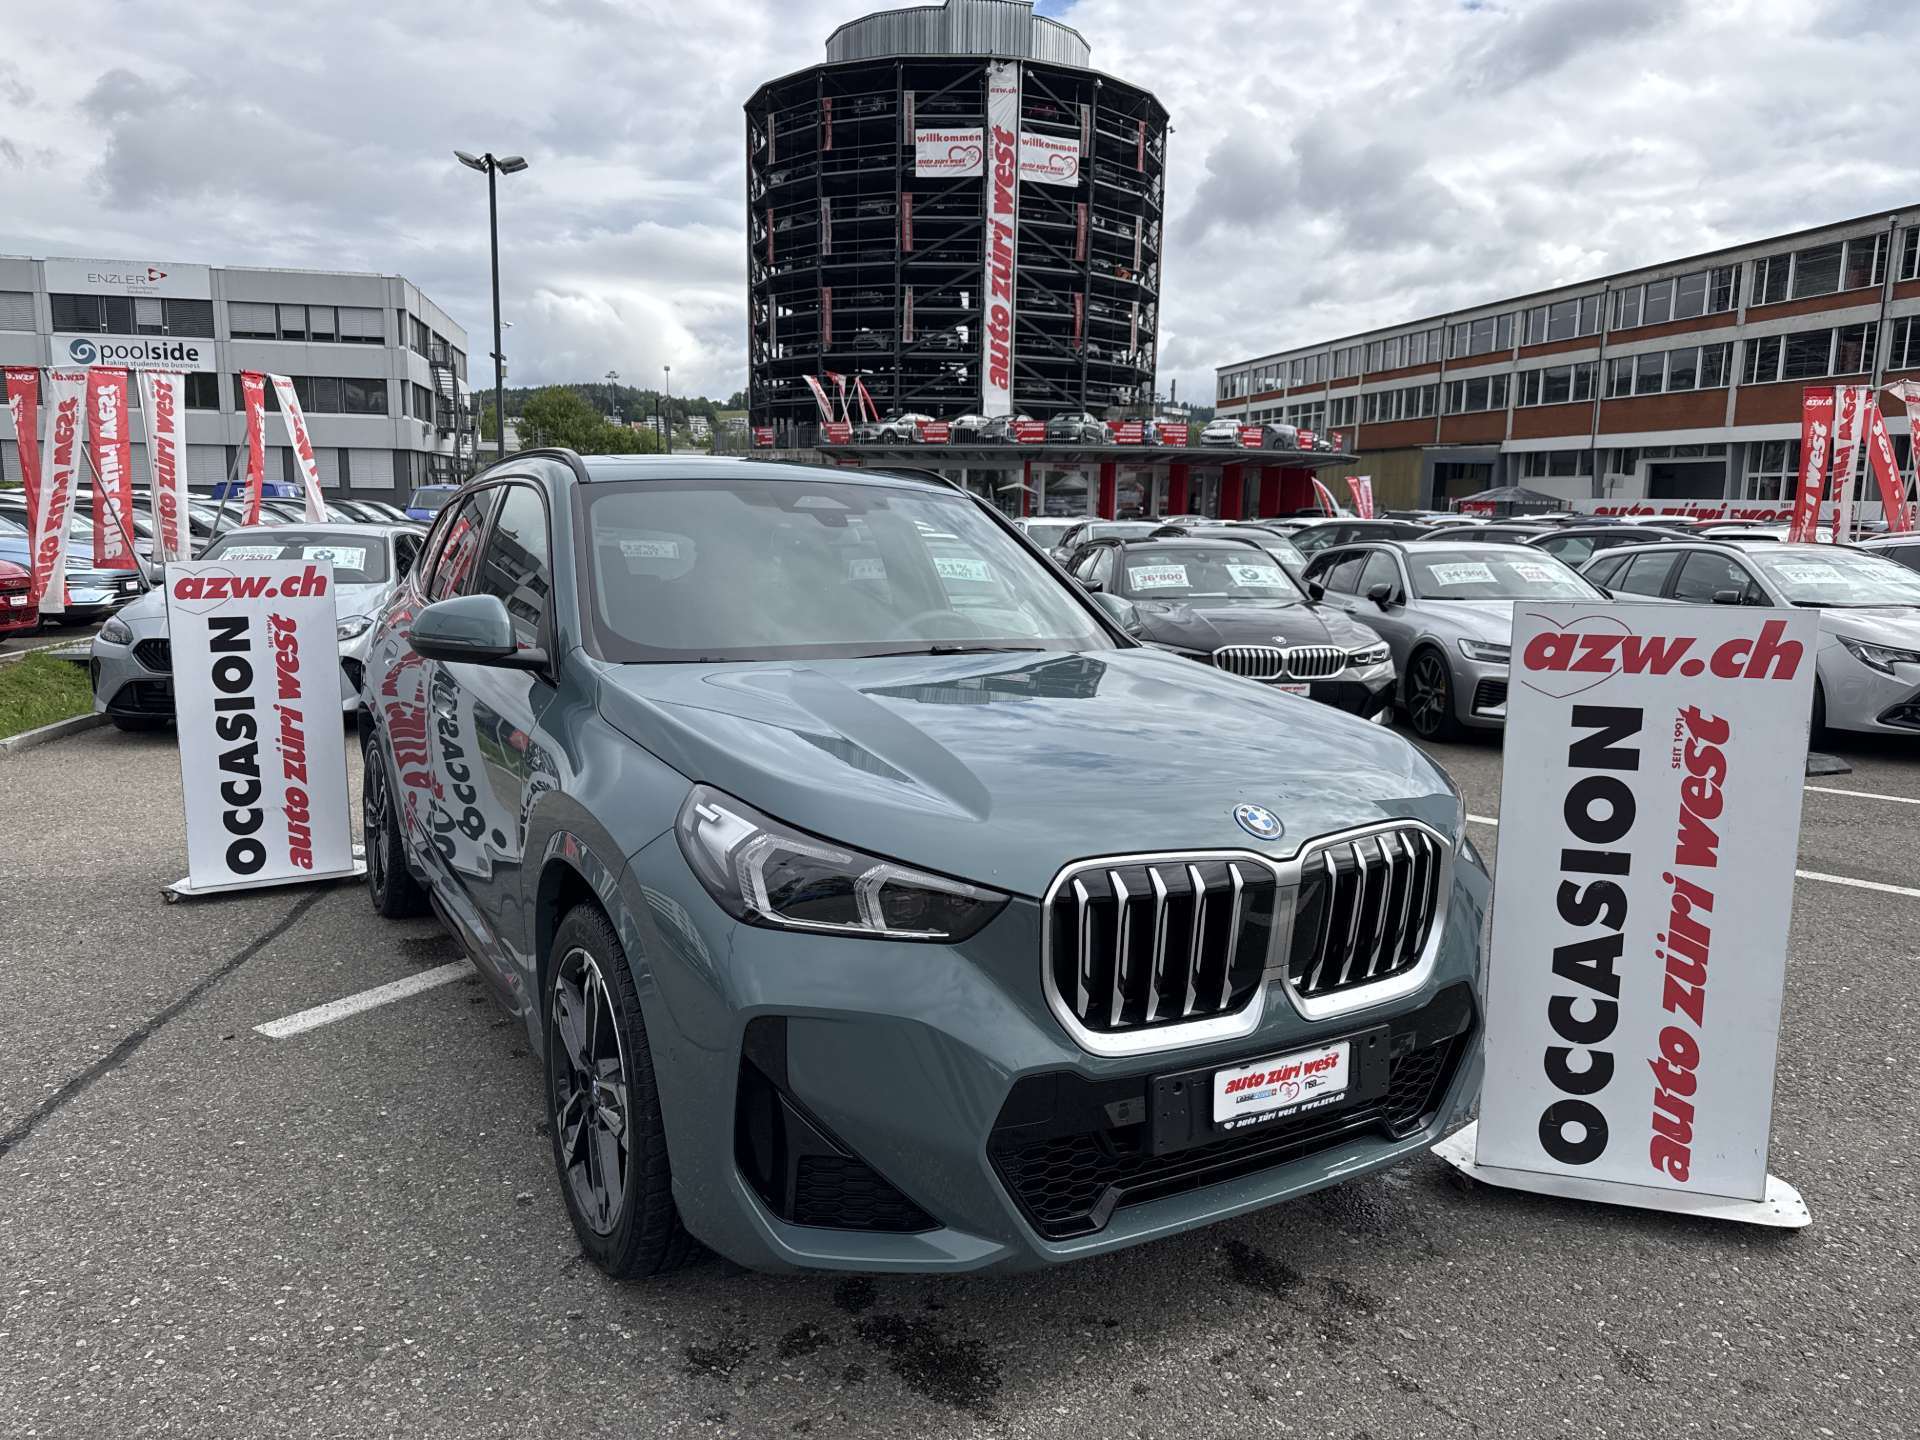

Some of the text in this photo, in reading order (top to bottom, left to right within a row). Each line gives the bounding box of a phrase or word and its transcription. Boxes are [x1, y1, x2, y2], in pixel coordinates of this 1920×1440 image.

[917, 133, 982, 143] willkommen
[1021, 137, 1078, 153] willkommen
[87, 273, 146, 285] ENZLER
[986, 124, 1015, 390] auto züri west
[100, 340, 199, 366] poolside
[152, 378, 174, 434] west
[153, 435, 176, 491] züri
[1805, 419, 1828, 489] west
[159, 492, 178, 553] auto
[173, 566, 327, 600] azw.ch
[1523, 619, 1805, 681] azw.ch
[207, 616, 266, 875] OCCASION
[273, 612, 314, 870] auto züri west
[1671, 716, 1685, 770] SEIT 1991
[1538, 704, 1644, 1166] OCCASION
[1645, 704, 1731, 1183] auto züri west
[1225, 1052, 1340, 1094] auto züri west
[1236, 1116, 1256, 1128] auto
[1257, 1111, 1276, 1123] züri
[1278, 1106, 1298, 1118] west
